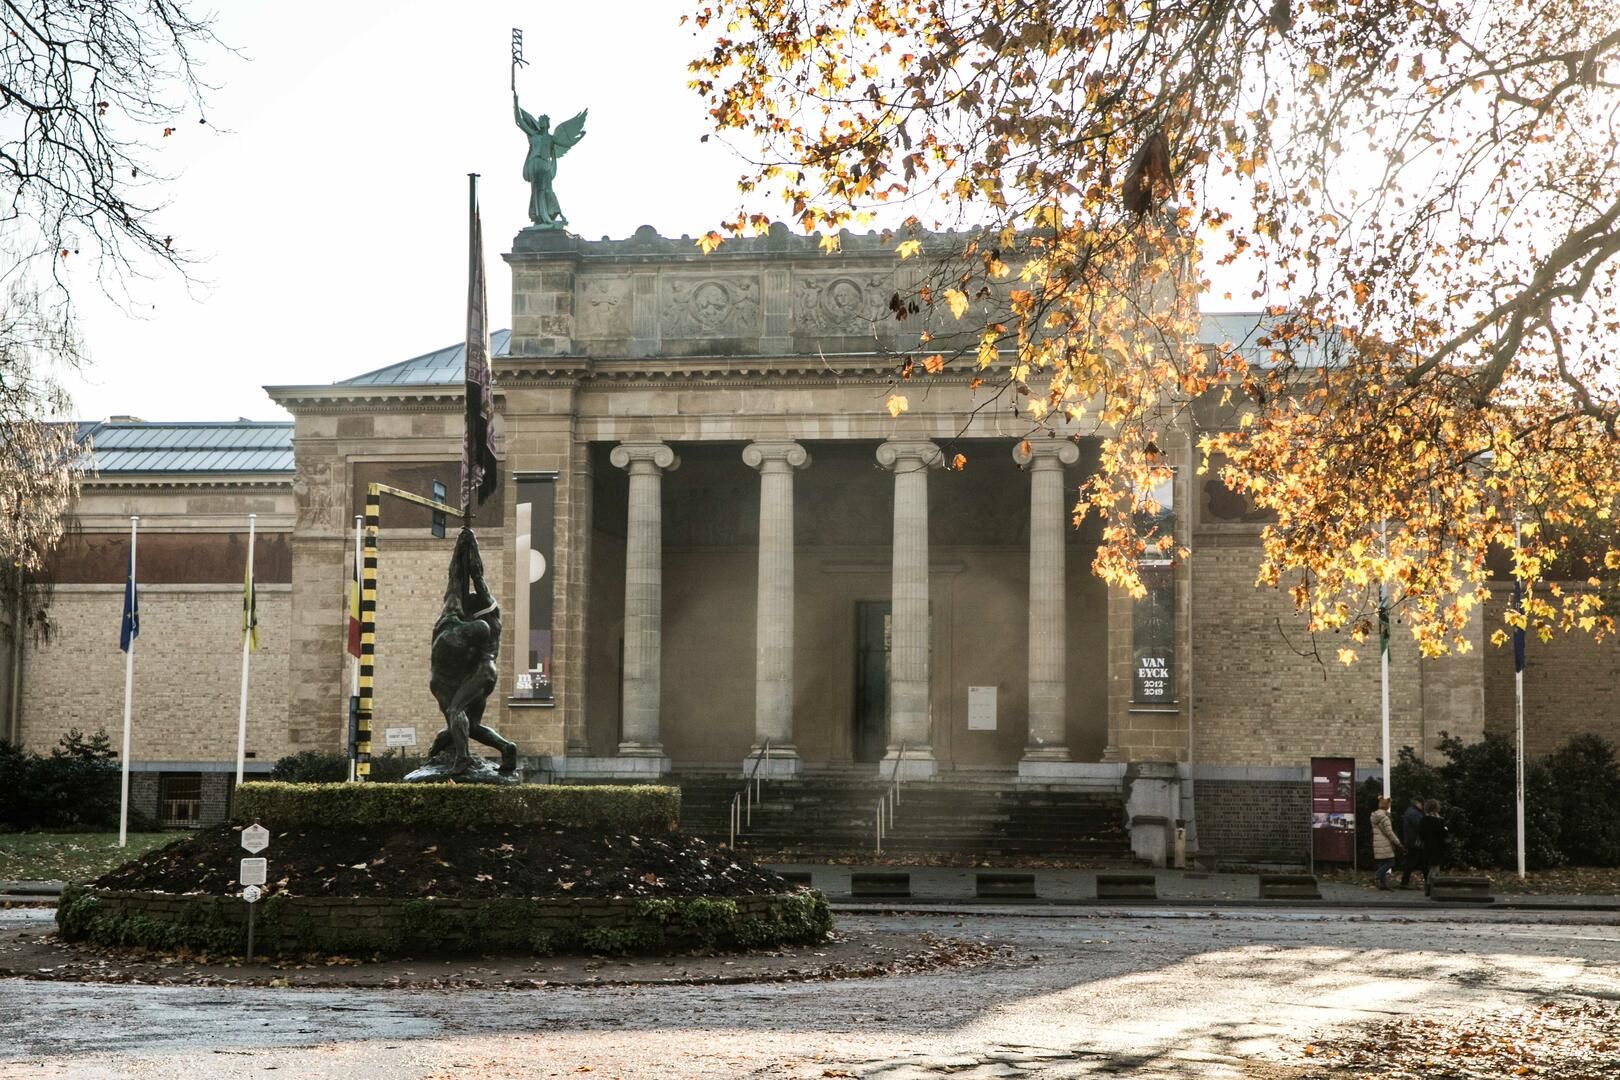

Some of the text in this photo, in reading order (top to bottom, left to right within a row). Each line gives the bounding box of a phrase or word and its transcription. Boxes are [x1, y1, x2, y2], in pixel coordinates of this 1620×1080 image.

[1142, 657, 1165, 667] VAN
[1138, 668, 1169, 678] EYCK
[1143, 680, 1167, 688] 2012-
[1143, 688, 1164, 696] 2019
